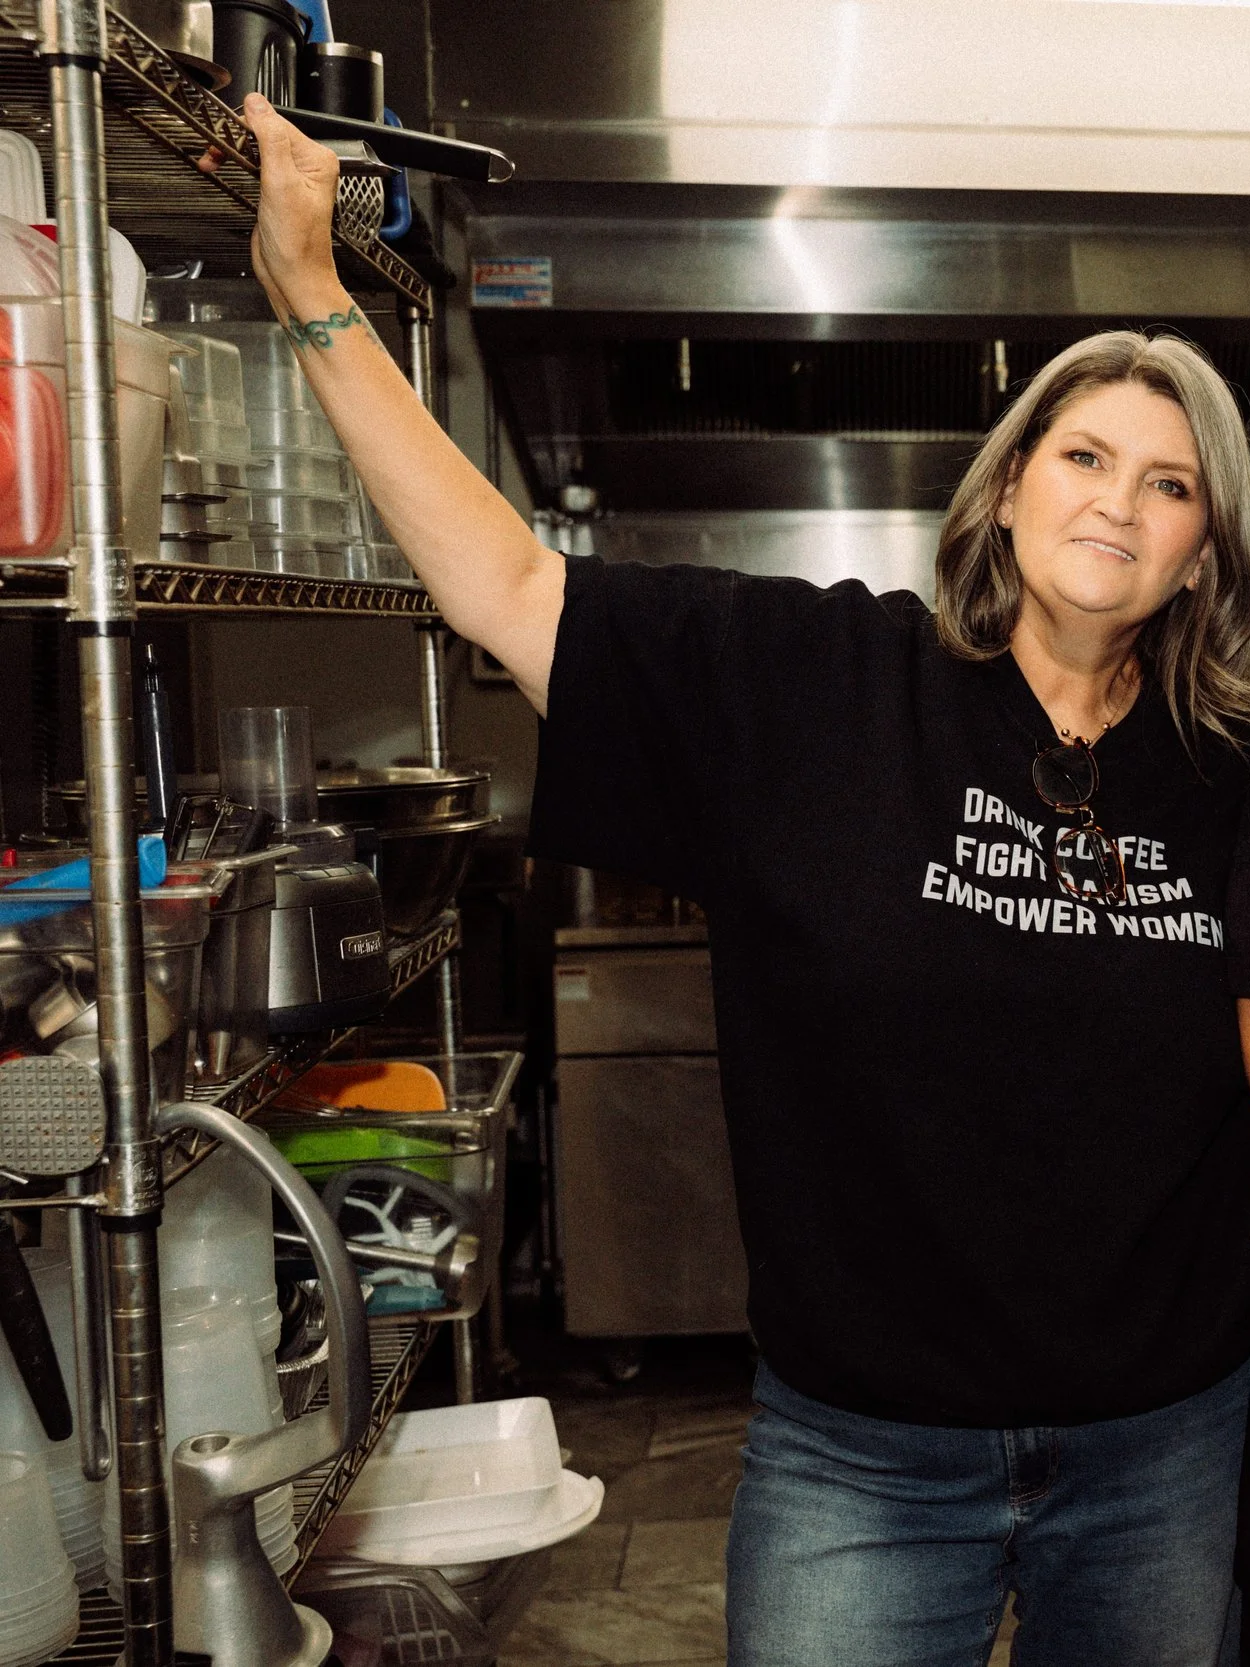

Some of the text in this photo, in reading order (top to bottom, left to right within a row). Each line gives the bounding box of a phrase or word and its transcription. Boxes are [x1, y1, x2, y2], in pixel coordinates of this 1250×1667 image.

[964, 787, 1045, 851] DRINK
[921, 861, 1224, 952] EMPOWER WOMEN
[955, 834, 1048, 882] FIGHT
[1057, 872, 1194, 907] RAISM
